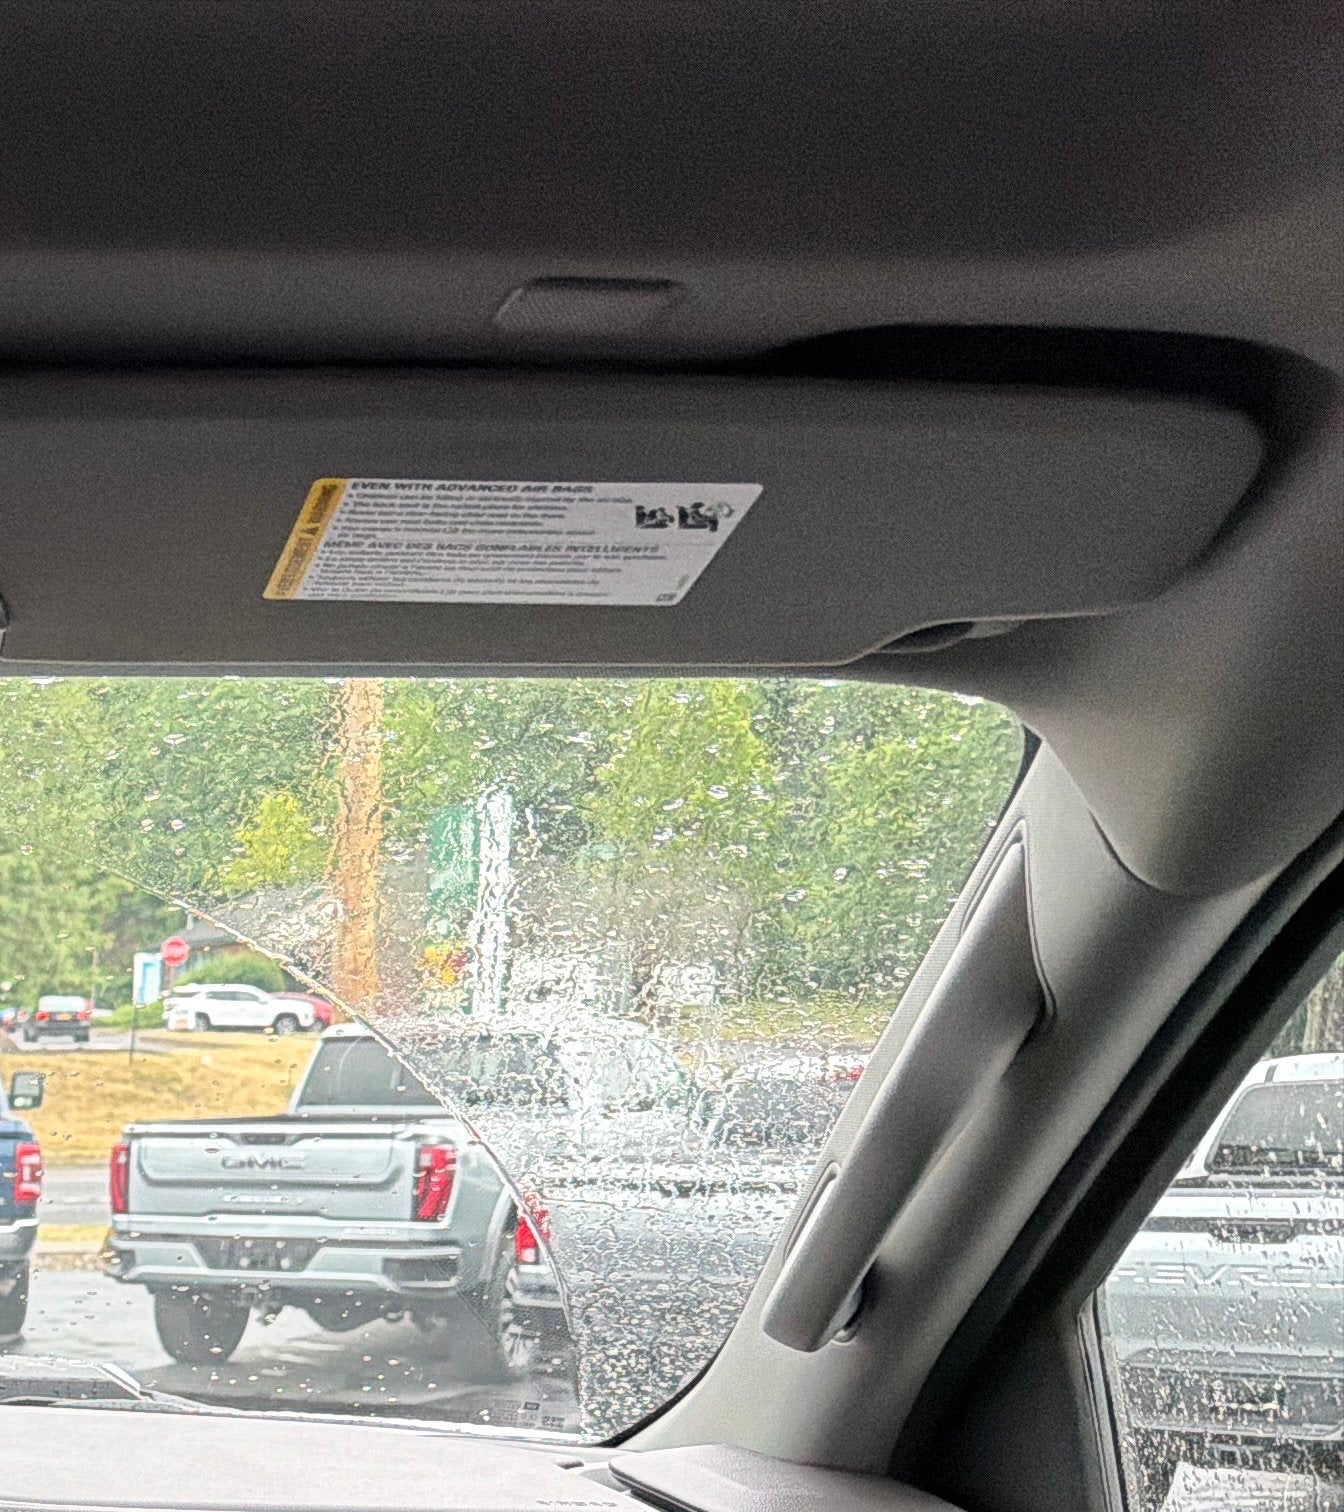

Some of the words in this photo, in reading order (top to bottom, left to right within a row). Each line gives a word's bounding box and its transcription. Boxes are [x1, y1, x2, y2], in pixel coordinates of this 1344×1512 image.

[352, 481, 391, 490] EVEN
[394, 482, 433, 491] WITH
[435, 483, 518, 492] ADVANCED
[221, 1155, 304, 1169] GMC
